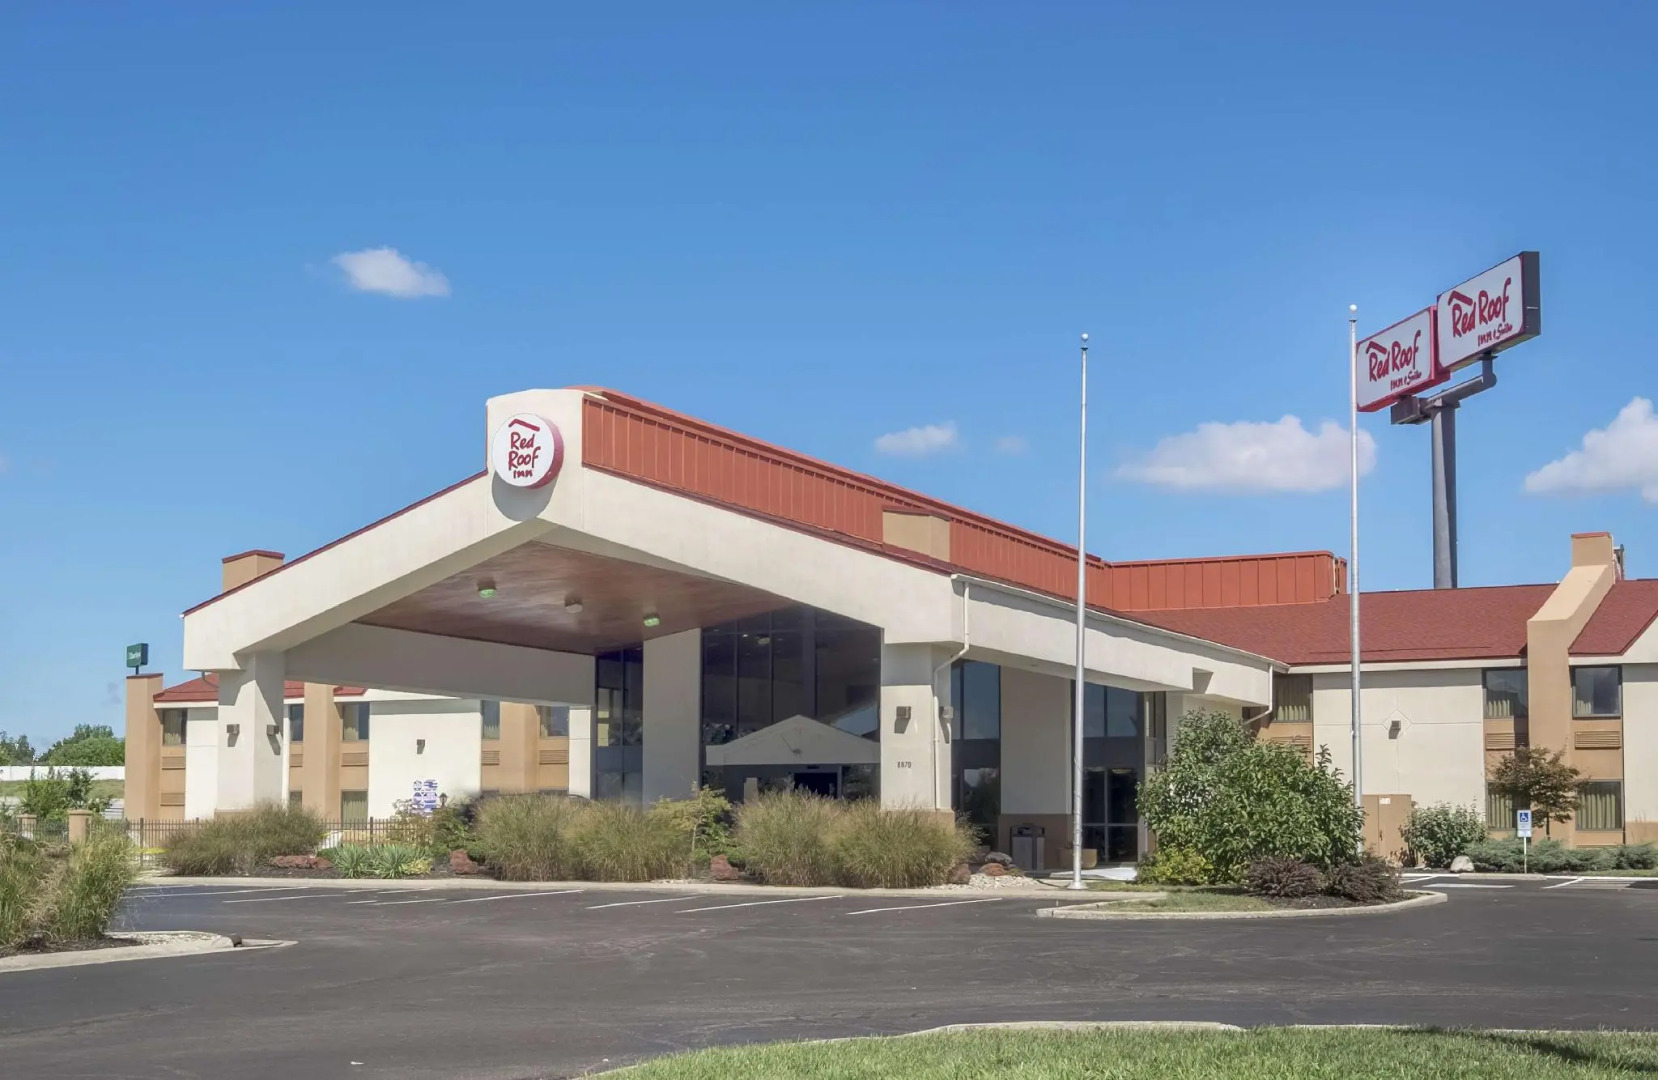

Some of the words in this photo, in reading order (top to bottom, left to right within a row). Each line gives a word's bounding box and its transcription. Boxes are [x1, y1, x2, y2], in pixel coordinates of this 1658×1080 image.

[1452, 303, 1477, 338] Red
[1478, 277, 1512, 325] Roof
[1369, 351, 1390, 382] Red
[1391, 329, 1421, 372] Roof
[508, 445, 541, 471] Roof
[510, 431, 535, 450] Red
